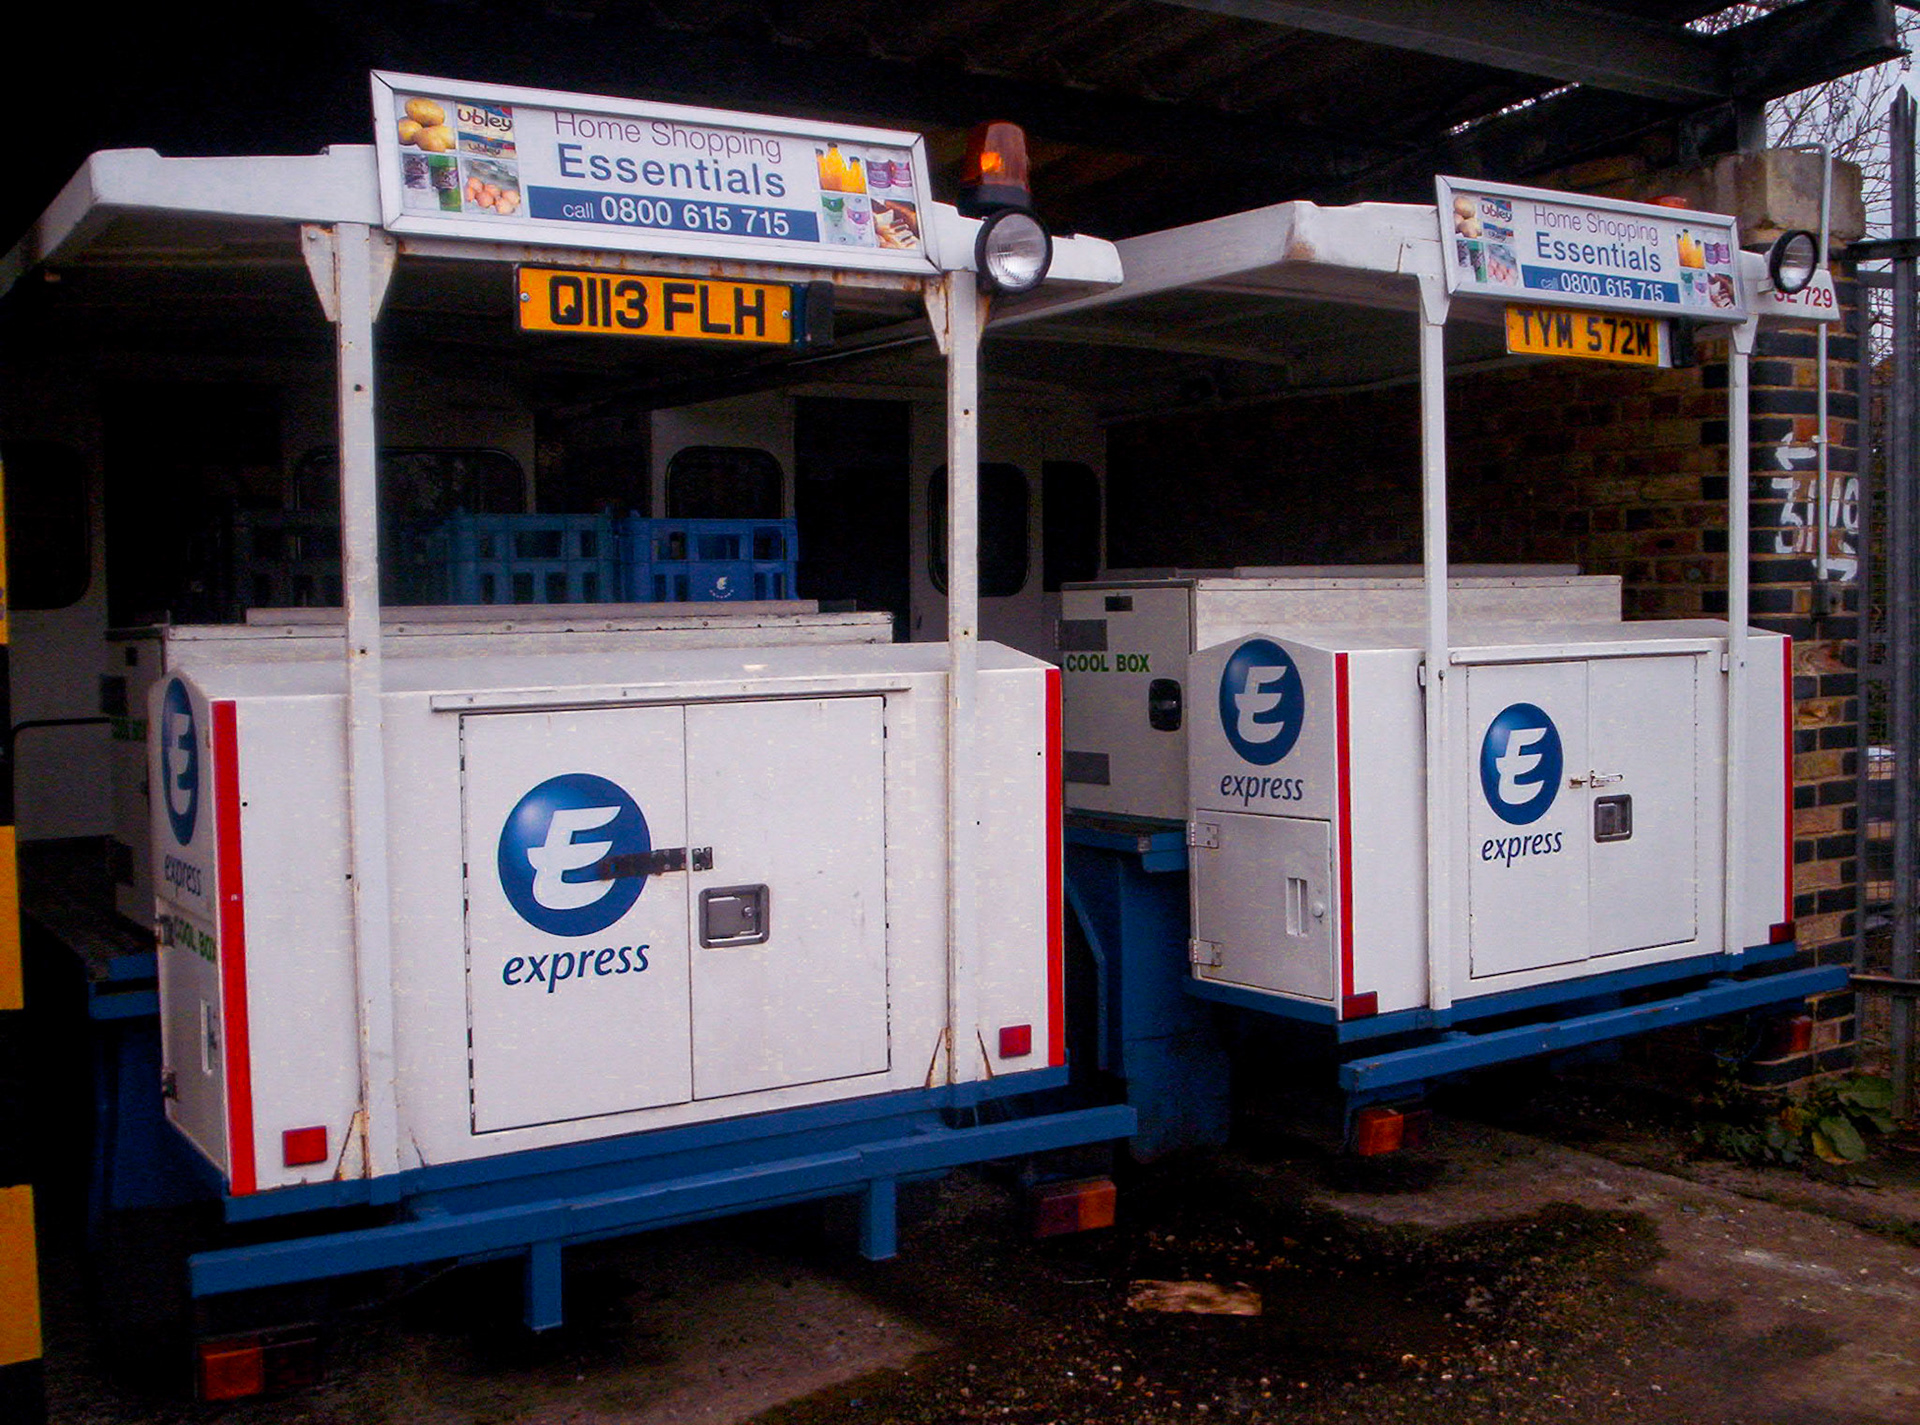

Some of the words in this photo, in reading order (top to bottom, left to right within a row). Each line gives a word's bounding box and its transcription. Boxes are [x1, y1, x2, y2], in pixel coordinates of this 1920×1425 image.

[555, 111, 641, 143] Home
[651, 120, 782, 164] Shopping
[558, 142, 786, 197] Essentials
[562, 202, 594, 220] call
[601, 196, 672, 227] 0800
[683, 203, 732, 232] 615
[741, 208, 789, 236] 715
[1534, 205, 1581, 231] Home
[1586, 212, 1659, 246] Shopping
[1536, 231, 1661, 273] Essentials
[550, 275, 648, 328] Q113
[663, 282, 765, 336] FLH
[1560, 272, 1600, 295] 0800
[1606, 278, 1633, 298] 615
[1638, 281, 1665, 301] 715
[1804, 286, 1832, 308] 729
[1517, 308, 1573, 349] TYM
[1587, 316, 1650, 357] 572M
[1066, 654, 1109, 672] COOL
[1116, 654, 1150, 672] BOX
[1220, 774, 1304, 806] express
[1481, 832, 1562, 868] express
[164, 854, 201, 897] express
[502, 944, 650, 993] express
